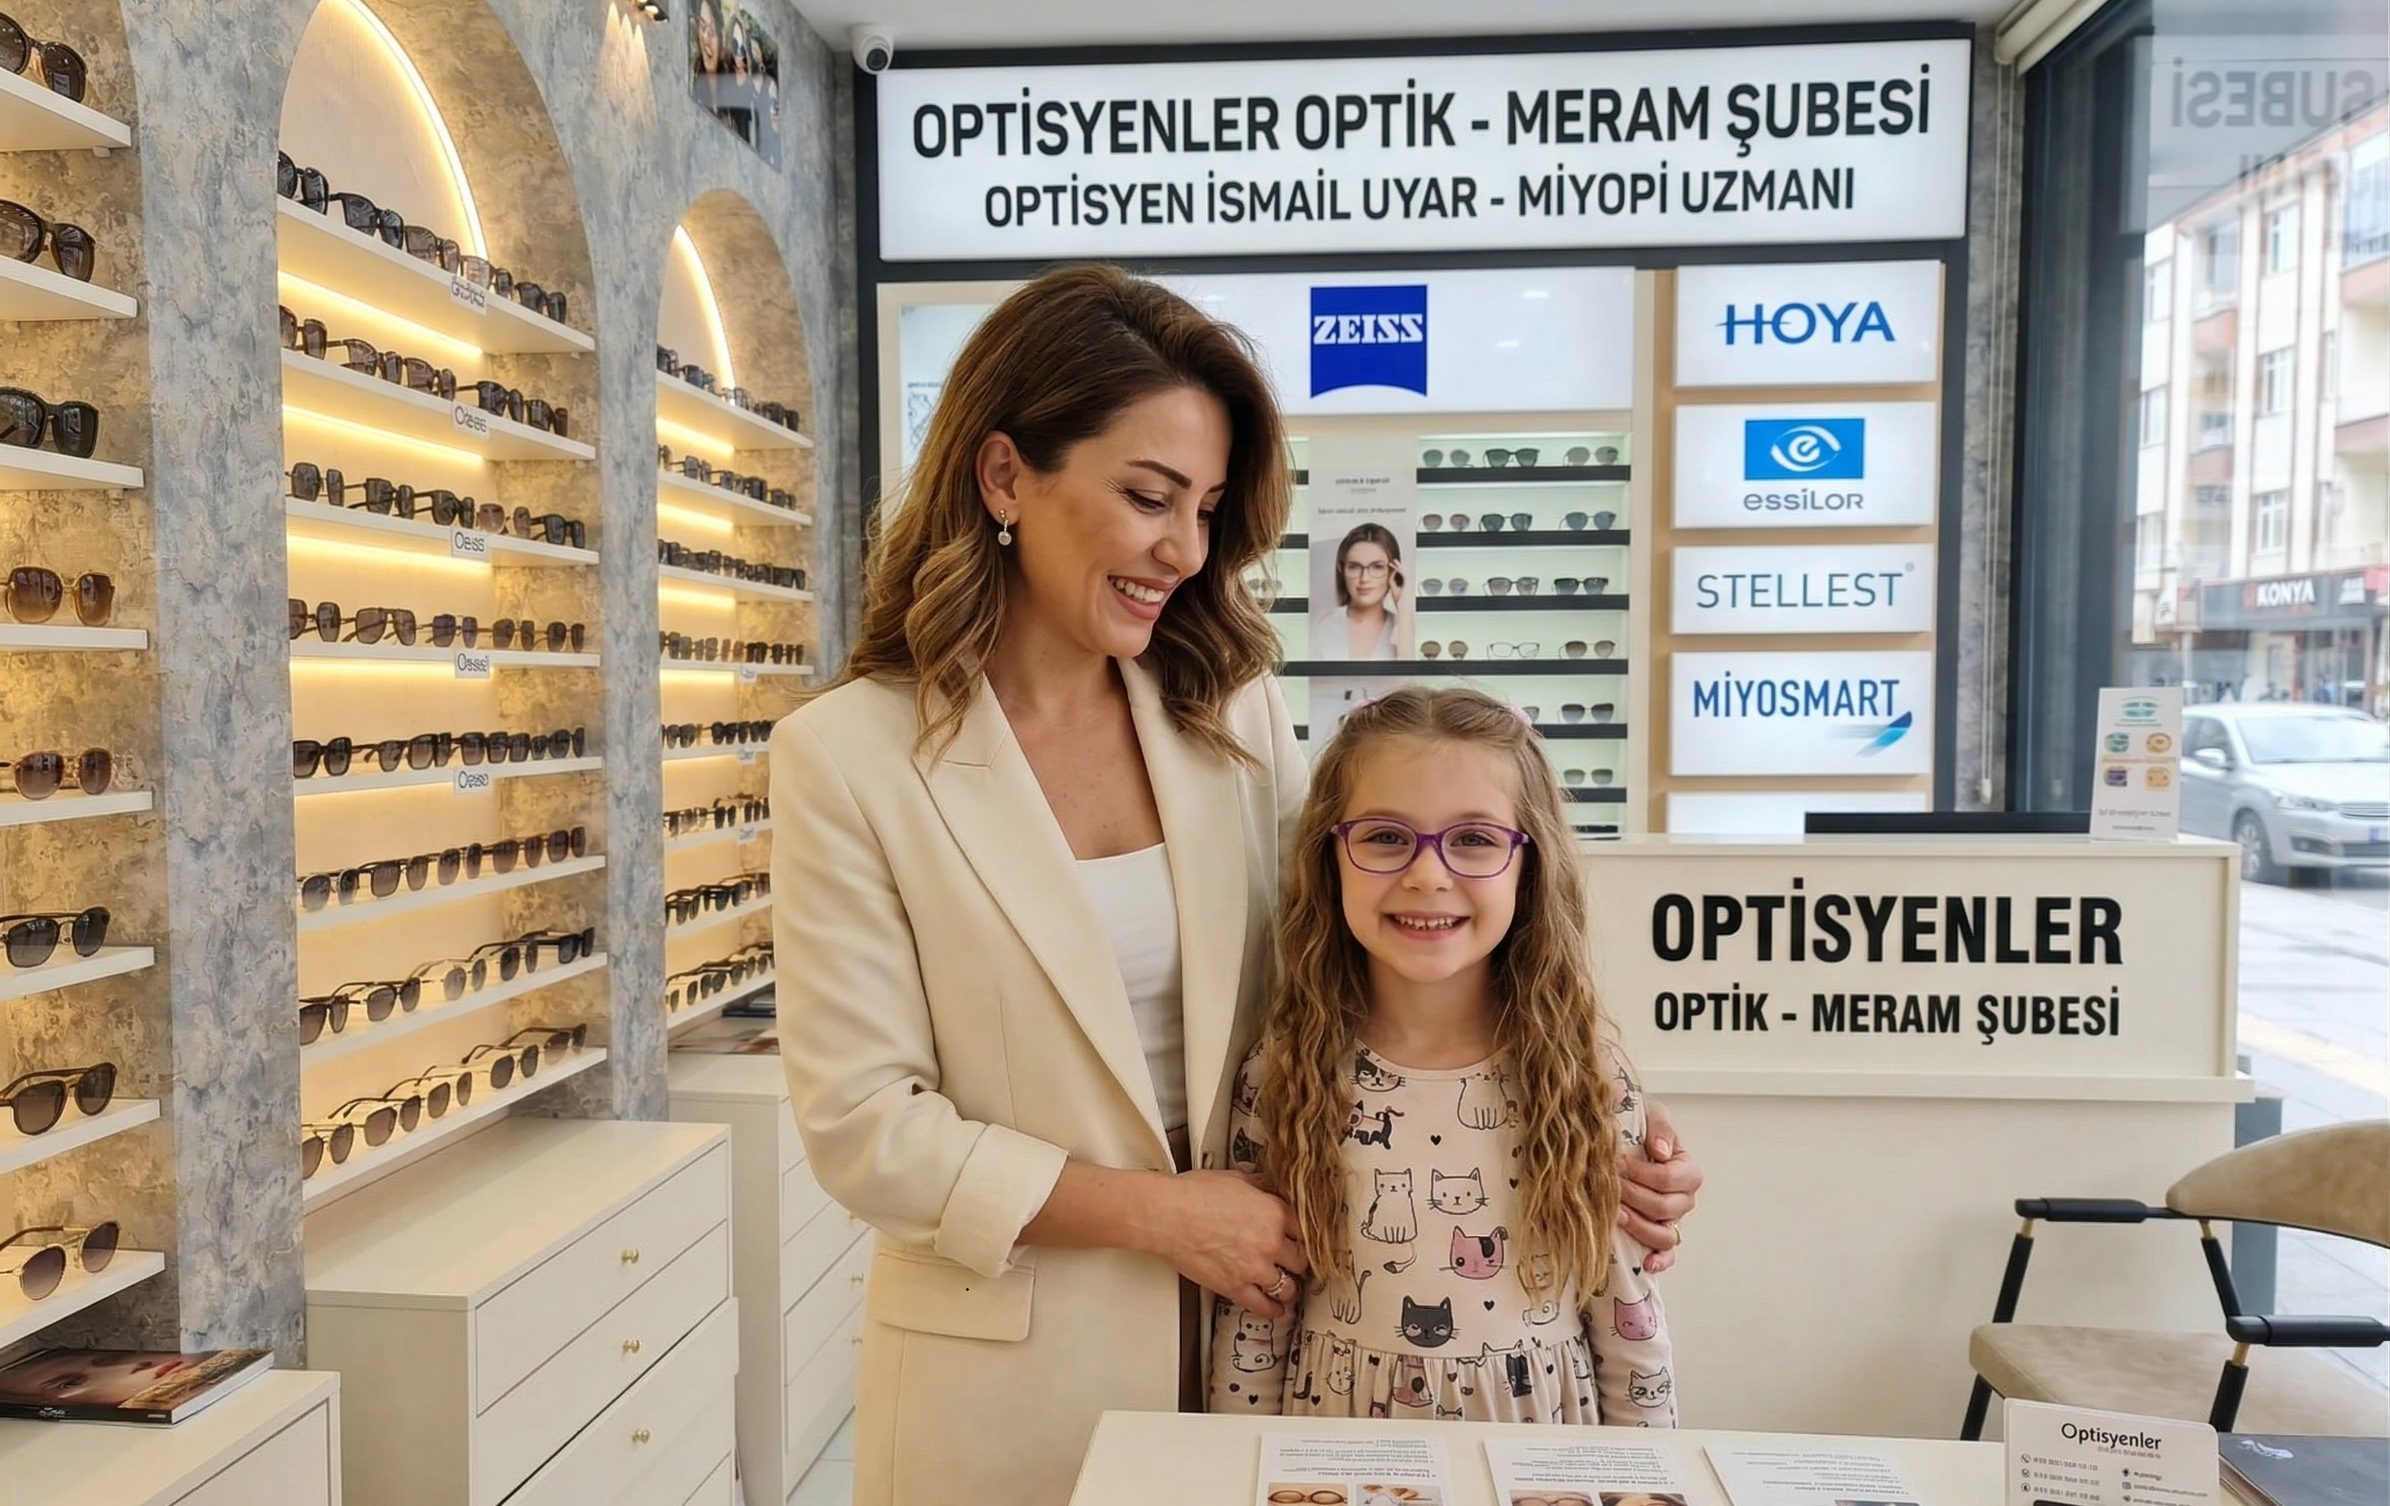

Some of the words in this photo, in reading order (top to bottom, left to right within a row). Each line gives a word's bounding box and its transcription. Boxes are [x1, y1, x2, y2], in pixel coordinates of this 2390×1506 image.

[913, 86, 1280, 159] OPTİSYENLER
[1295, 78, 1456, 152] OPTİK
[1471, 120, 1489, 131] -
[1507, 85, 1709, 145] MERAM
[1727, 63, 1930, 158] ŞUBESİ
[985, 173, 1194, 228] OPTİSYEN
[1207, 168, 1351, 223] İSMAİL
[1363, 177, 1477, 220] UYAR
[1490, 197, 1504, 206] -
[1519, 160, 1668, 216] MİYOPİ
[1682, 167, 1854, 214] UZMANI
[1313, 313, 1423, 345] ZEISS
[1718, 301, 1895, 345] HOYA
[1697, 572, 1903, 609] STELLEST
[2256, 577, 2315, 607] KONYA
[1694, 671, 1900, 718] MİYOSMART
[1652, 877, 2123, 965] OPTİSYENLER
[1654, 982, 1769, 1032] OPTİK
[1781, 1013, 1797, 1021] -
[1812, 993, 1960, 1034] MERAM
[1977, 986, 2119, 1045] ŞUBESİ
[2060, 1422, 2162, 1451] Optisyenler
